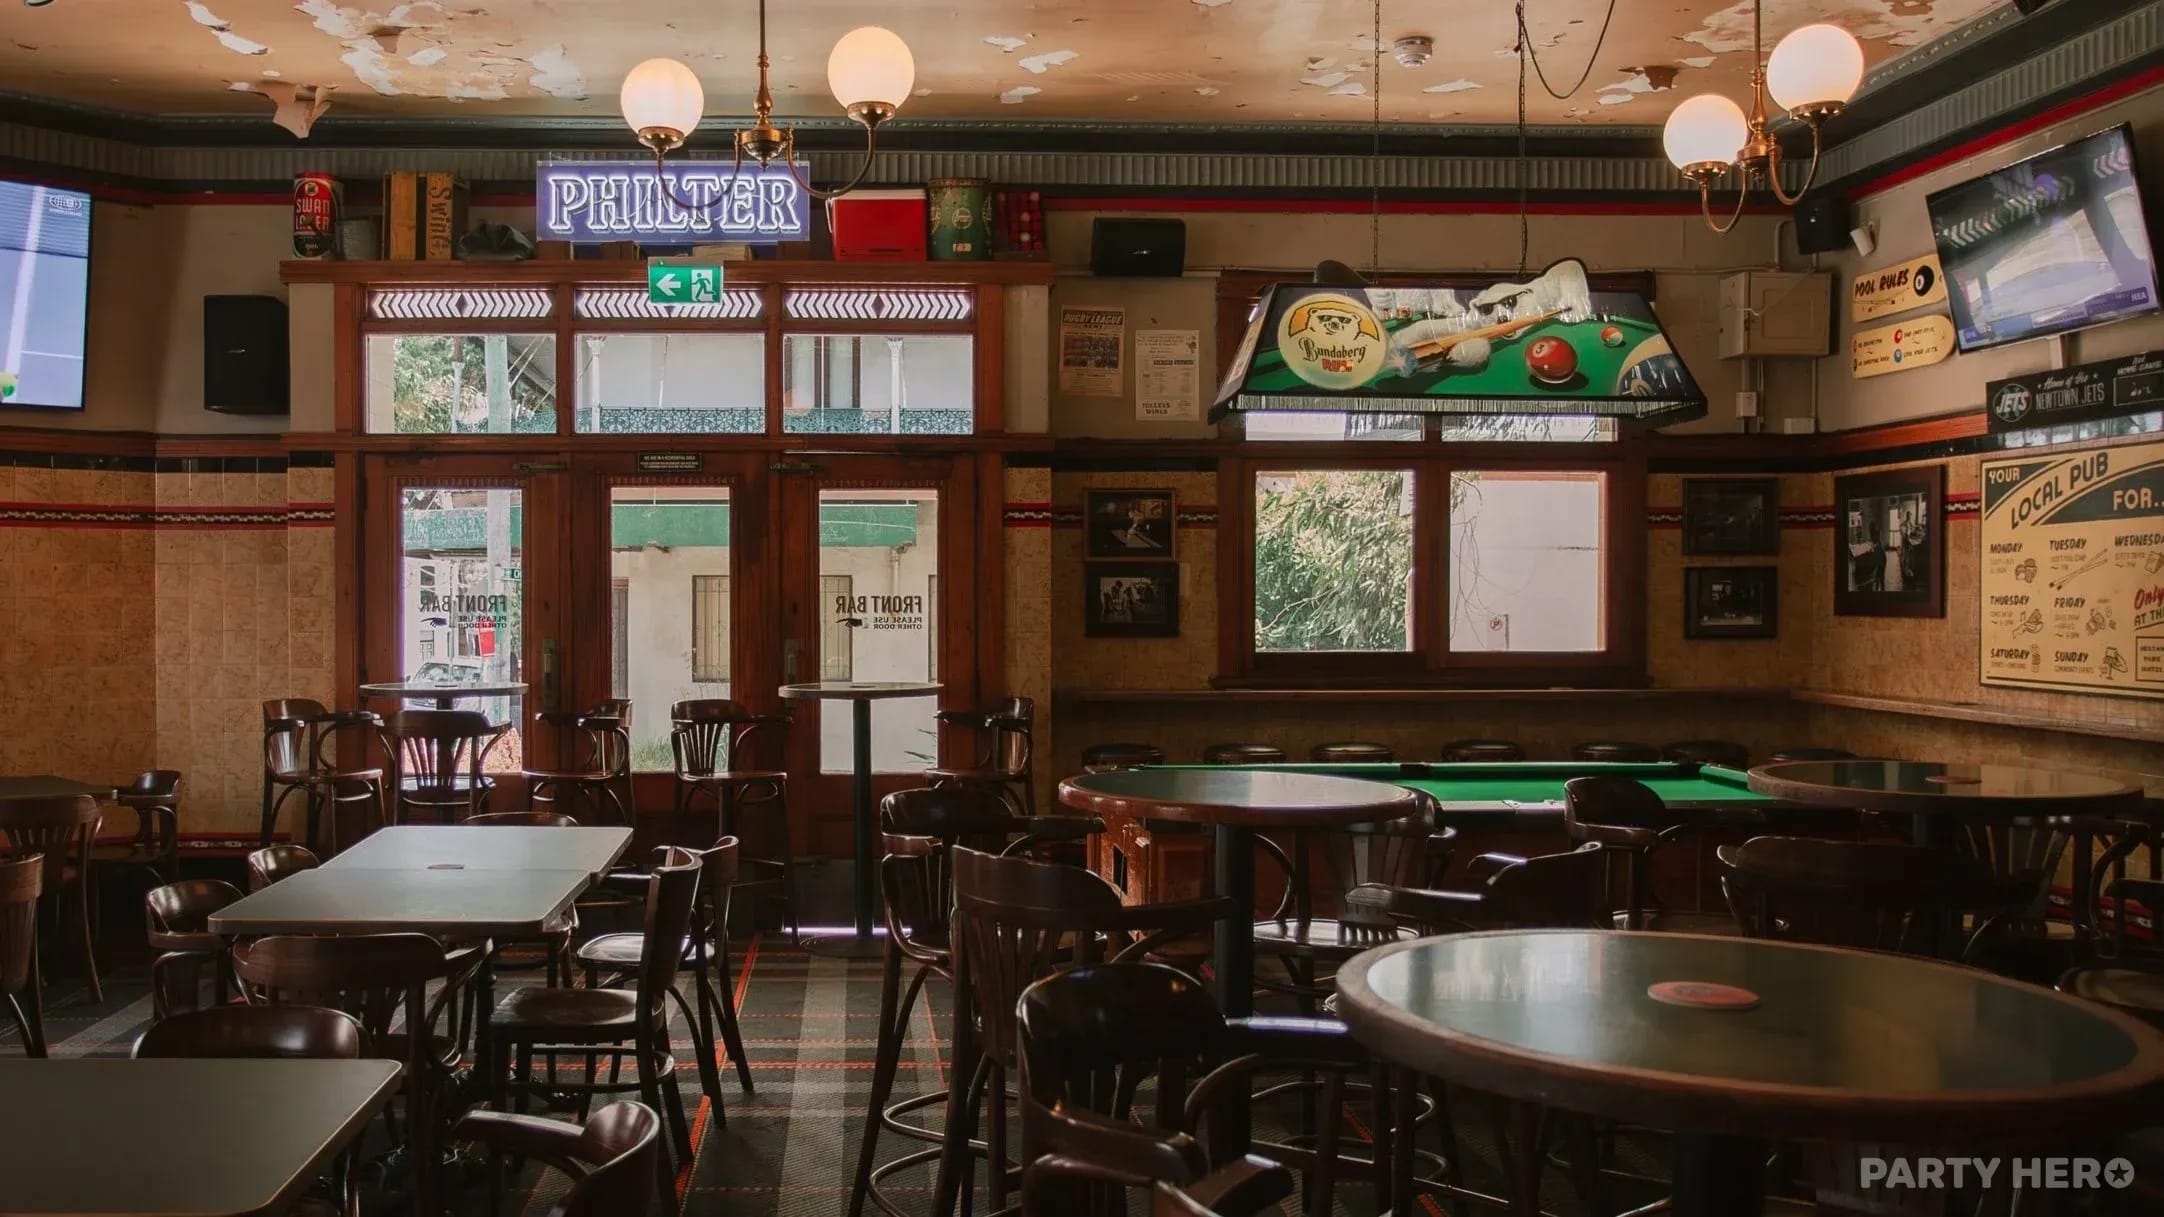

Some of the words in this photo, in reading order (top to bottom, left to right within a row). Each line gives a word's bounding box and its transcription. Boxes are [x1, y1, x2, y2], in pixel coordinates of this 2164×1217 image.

[296, 199, 330, 213] SWAN
[549, 175, 802, 233] PHILTER
[1855, 280, 1875, 297] POOL
[1879, 268, 1909, 291] RULES
[1064, 314, 1091, 322] RUGBY
[1090, 315, 1122, 324] LEAGUE
[1298, 337, 1367, 363] Bundaberg
[2117, 365, 2137, 376] HOME
[2139, 360, 2162, 371] GAME
[2044, 376, 2065, 390] Home
[1996, 390, 2031, 414] JETS
[2036, 387, 2079, 410] NEWTOWN
[2081, 382, 2105, 404] JETS
[1988, 467, 2020, 484] YOUR
[2011, 475, 2063, 530] LOCAL
[2070, 452, 2108, 490] PUB
[1990, 542, 2023, 553] MONDAY
[2049, 538, 2087, 551] TUESDAY
[1990, 595, 2030, 606] THURSDAY
[2054, 597, 2087, 608] FRIDAY
[2134, 586, 2164, 610] Only
[2134, 612, 2146, 626] AT
[2149, 606, 2164, 621] TH
[1990, 648, 2030, 660] SATURDAY
[2054, 651, 2089, 663] SUNDAY
